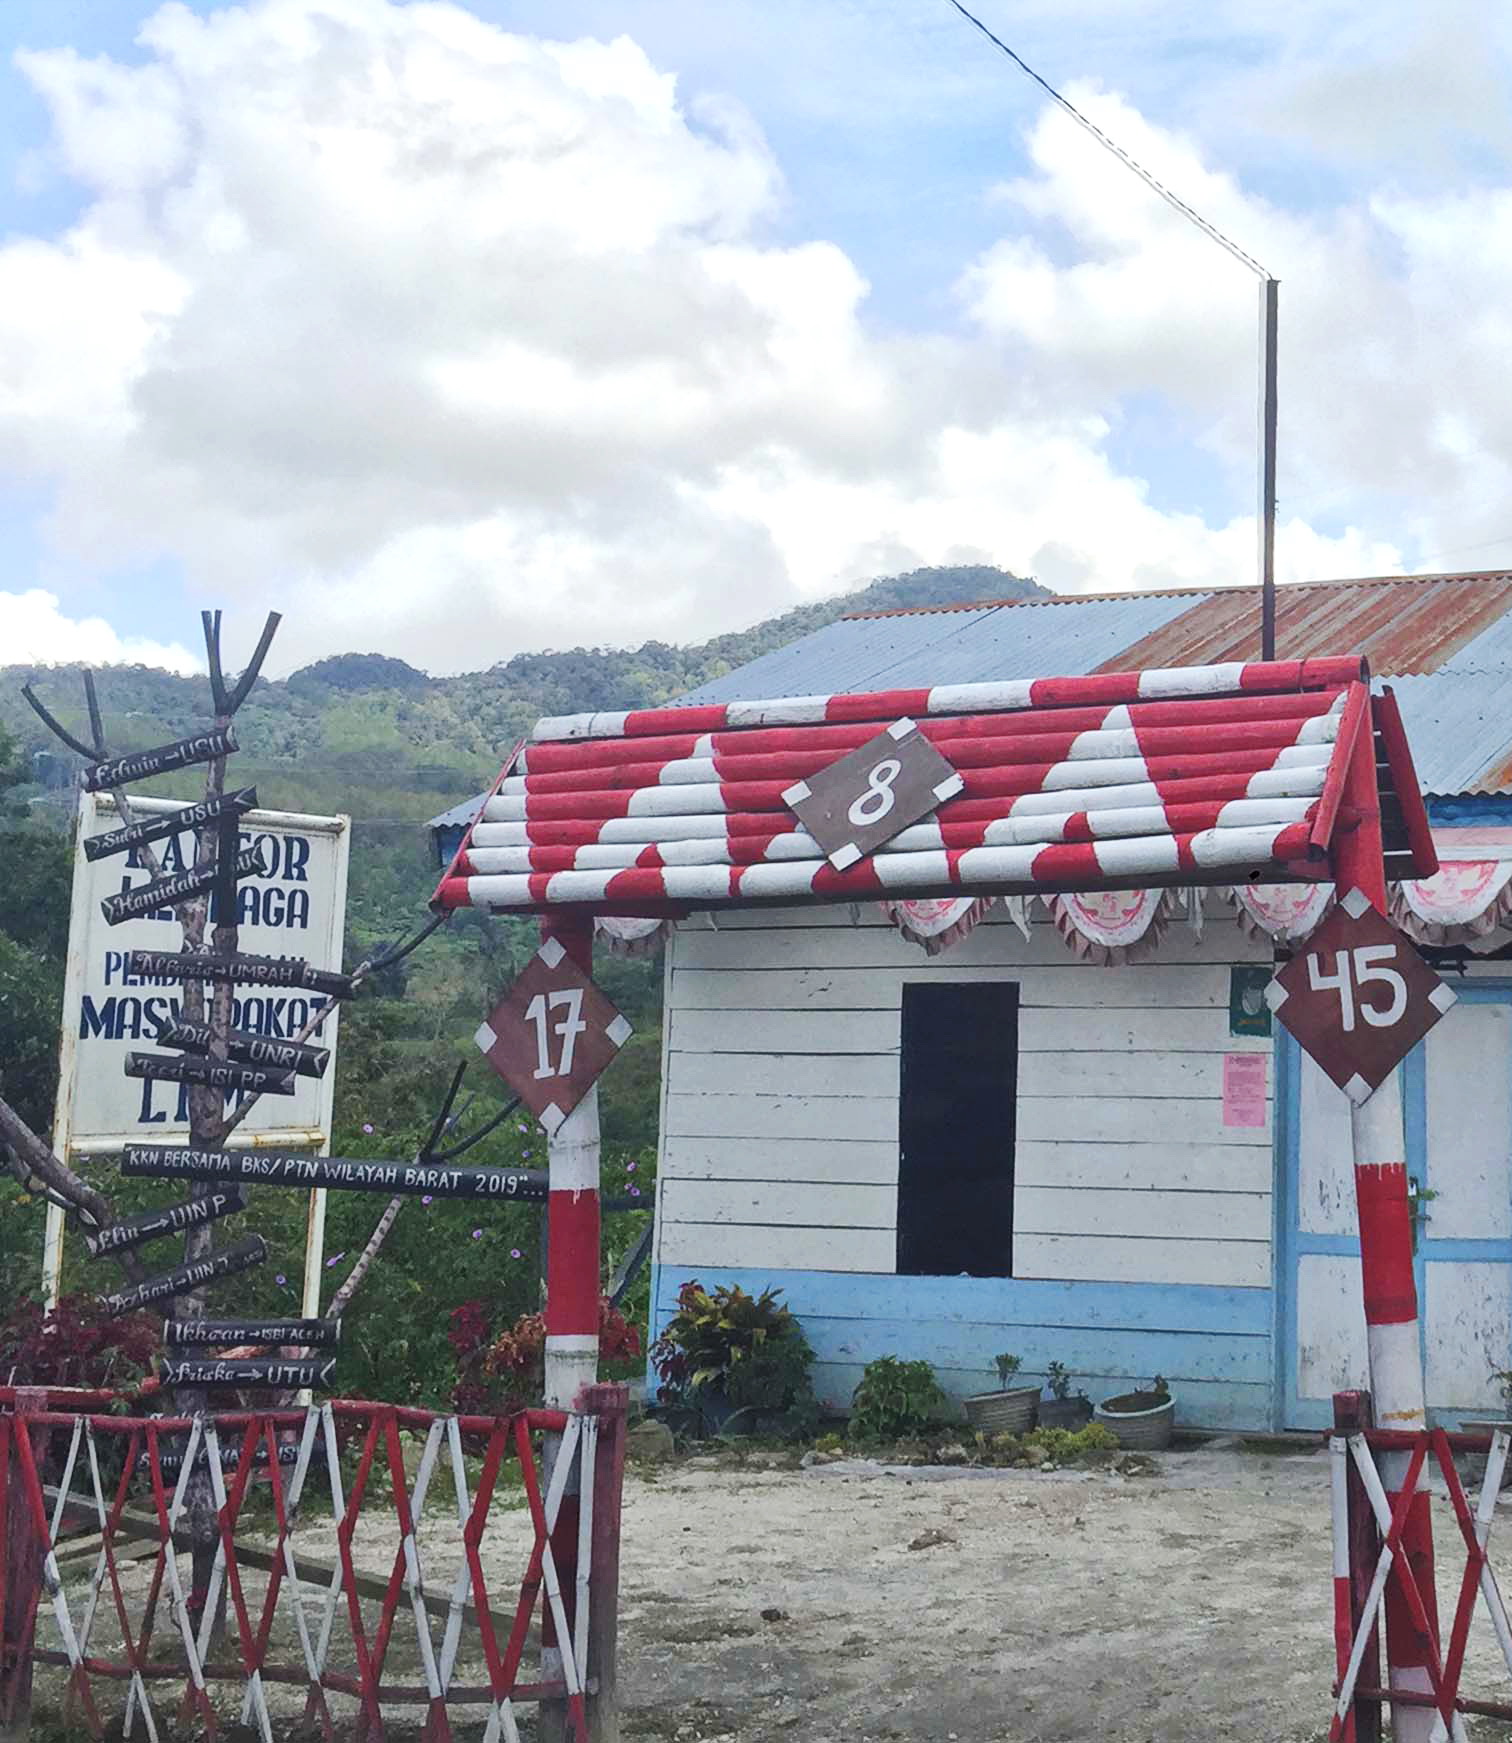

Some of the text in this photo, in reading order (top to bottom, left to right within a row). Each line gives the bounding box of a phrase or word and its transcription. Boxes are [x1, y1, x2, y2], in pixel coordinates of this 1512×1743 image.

[179, 735, 225, 761] USU
[848, 759, 902, 826] 8
[180, 800, 221, 825] USU
[113, 870, 201, 916] Hamidah
[229, 963, 294, 981] UMRAH
[1306, 944, 1408, 1032] 45
[524, 988, 587, 1080] 17
[251, 1040, 303, 1068] UNRI
[210, 1067, 233, 1086] ISI
[241, 1071, 267, 1089] PP
[163, 1151, 231, 1172] BERSAMA
[322, 1162, 398, 1184] WILAYAH
[405, 1168, 463, 1190] BARAT
[170, 1201, 208, 1228] UIN
[267, 1366, 315, 1385] UTU
